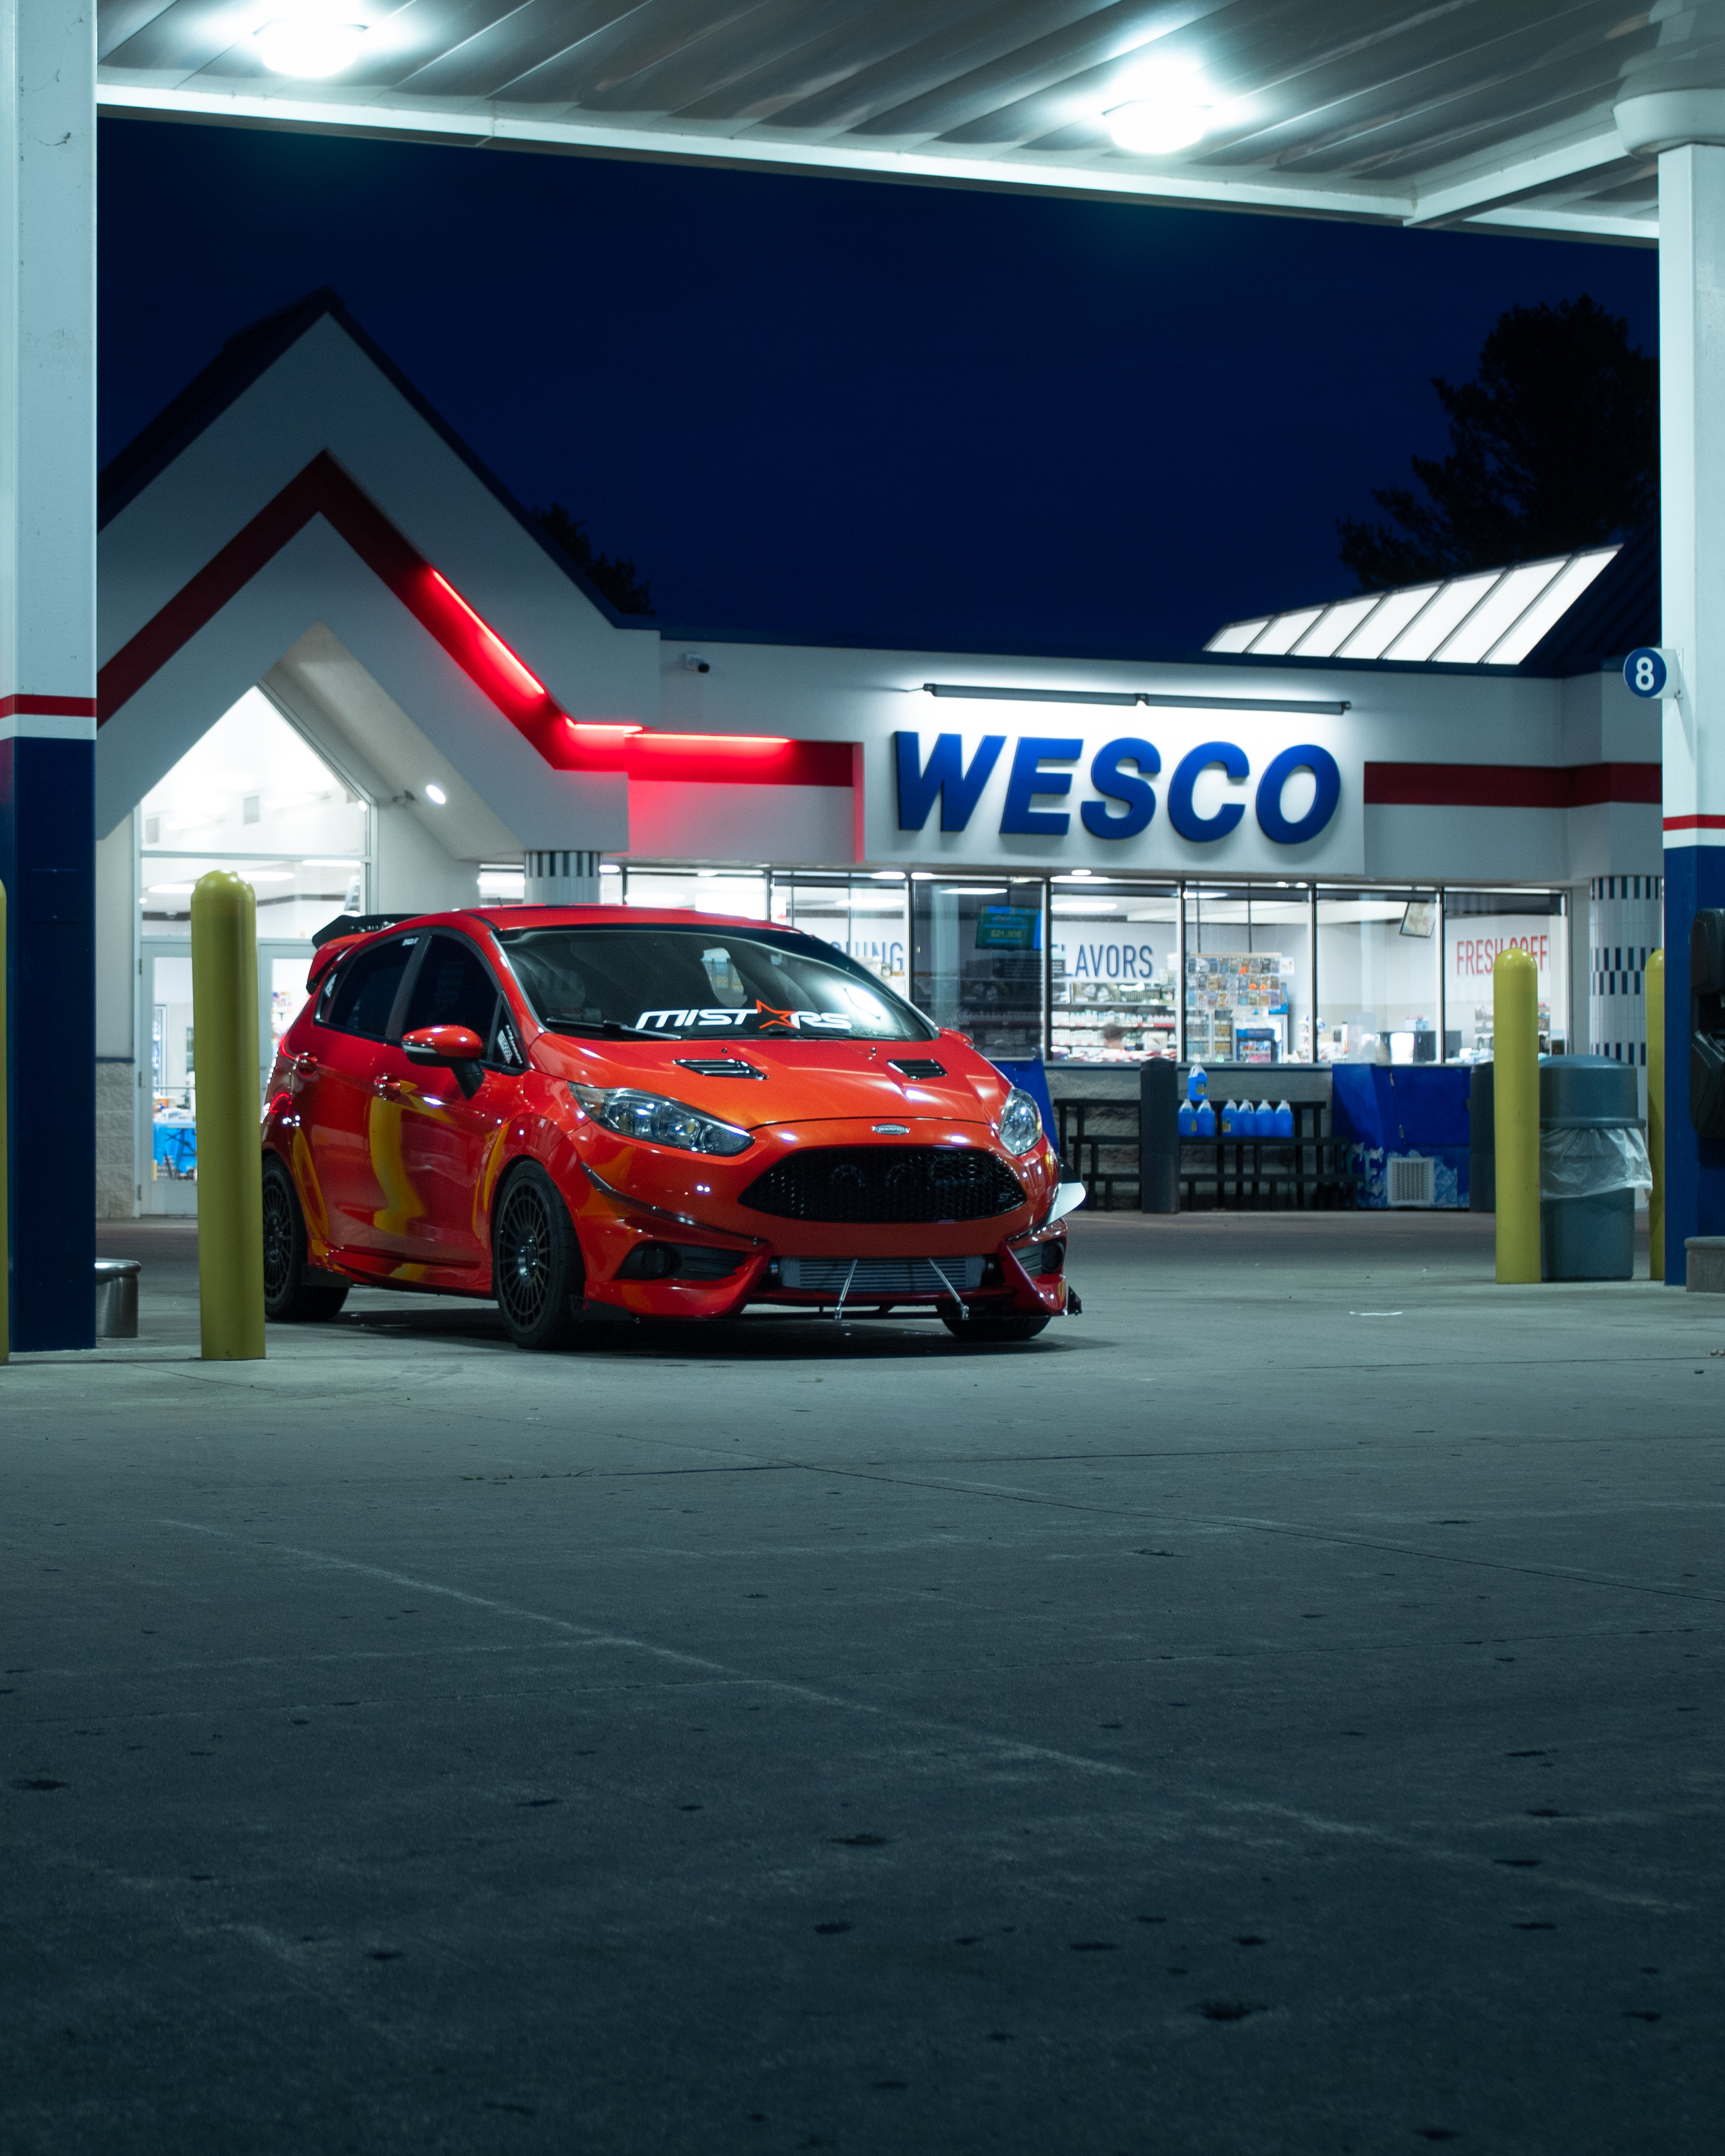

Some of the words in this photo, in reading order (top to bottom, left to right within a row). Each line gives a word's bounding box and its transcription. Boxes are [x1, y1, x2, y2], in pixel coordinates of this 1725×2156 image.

[1635, 656, 1655, 691] 8
[893, 730, 1341, 845] WESCO
[1051, 943, 1154, 979] AVORS
